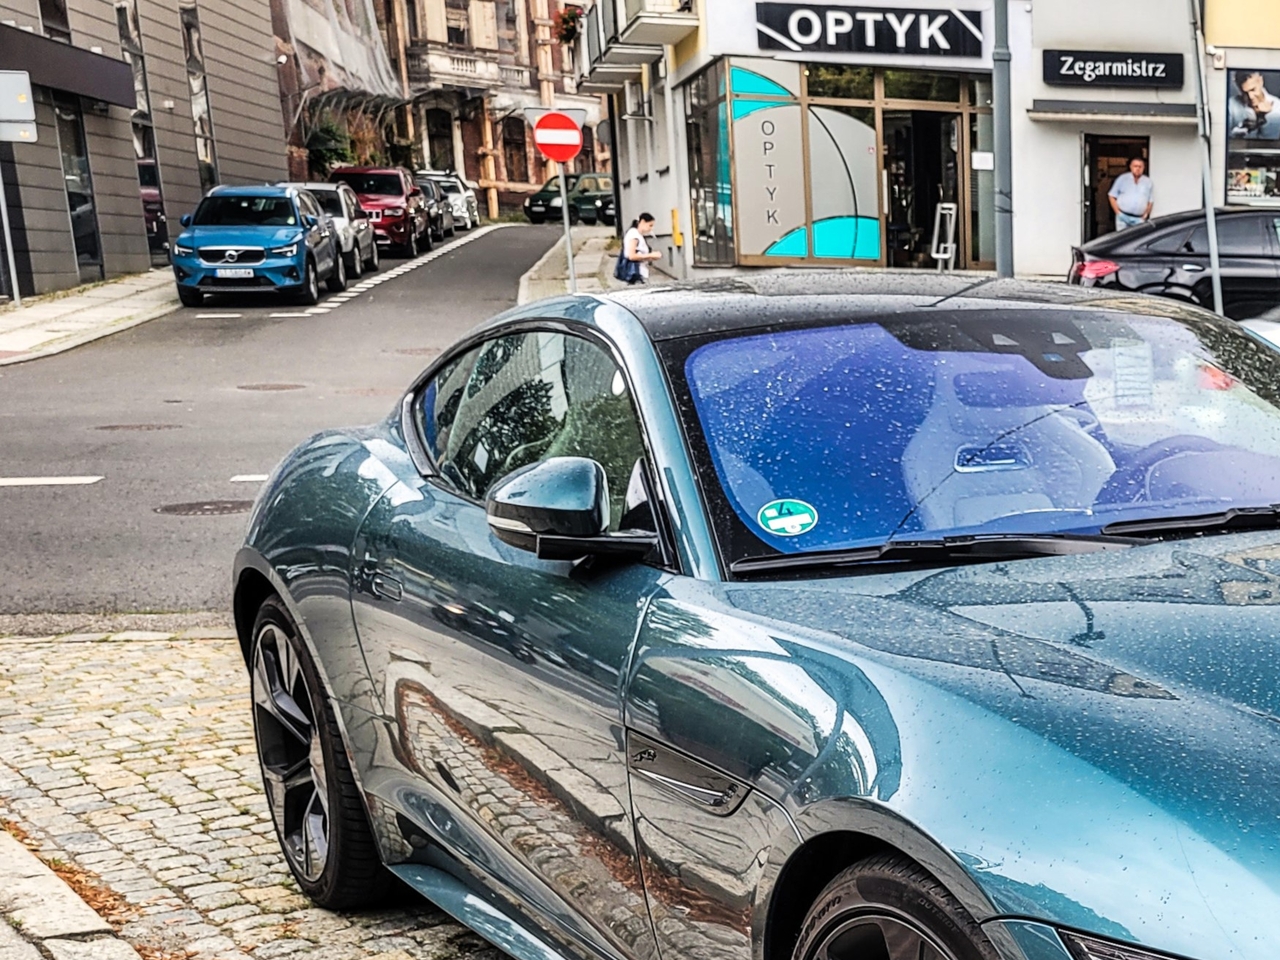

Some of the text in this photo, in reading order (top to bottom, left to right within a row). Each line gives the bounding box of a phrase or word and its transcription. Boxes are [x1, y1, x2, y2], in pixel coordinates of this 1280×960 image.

[787, 9, 950, 49] OPTYK
[1060, 56, 1166, 81] Zegarmistrz
[761, 120, 779, 225] OPTYK
